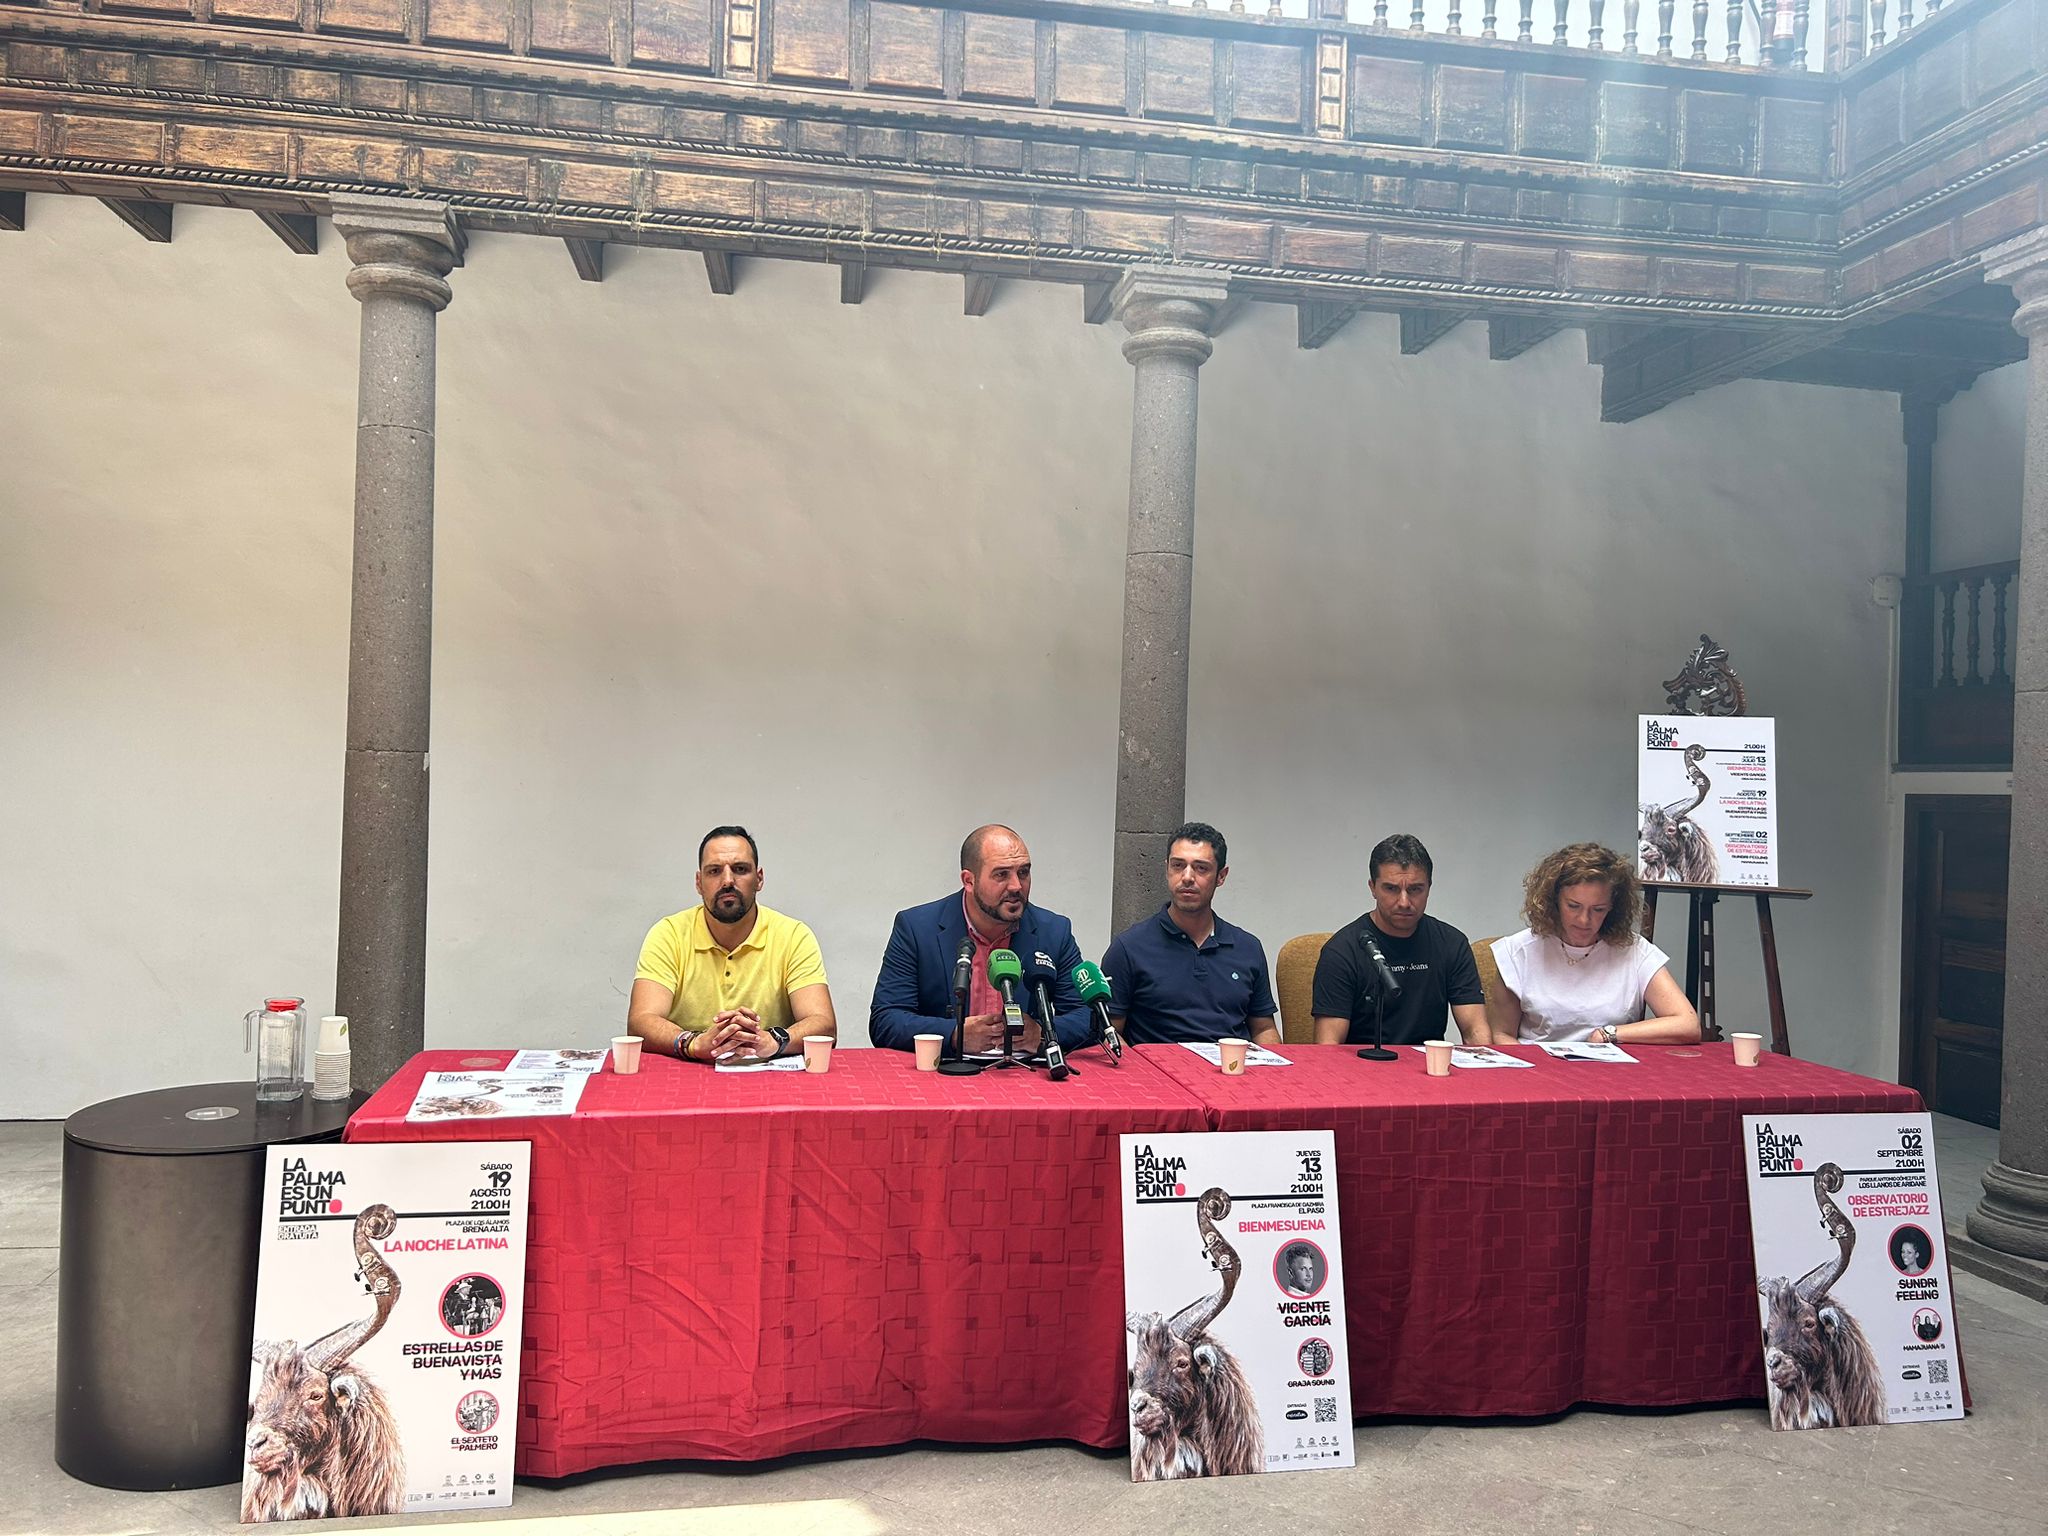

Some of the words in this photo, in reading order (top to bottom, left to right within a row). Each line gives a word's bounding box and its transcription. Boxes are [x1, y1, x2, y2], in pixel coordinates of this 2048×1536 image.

[1756, 1123, 1773, 1135] LA
[1757, 1135, 1802, 1147] PALMA
[1902, 1135, 1922, 1149] 02
[1134, 1145, 1154, 1158] LA
[1758, 1147, 1775, 1159] ES
[1776, 1147, 1794, 1159] UN
[1877, 1150, 1923, 1158] SEPTIEMBRE
[283, 1158, 306, 1172] LA
[1135, 1157, 1186, 1171] PALMA
[1301, 1158, 1321, 1172] 13
[282, 1171, 346, 1186] PALMA
[488, 1172, 511, 1188] 19
[1136, 1171, 1154, 1184] ES
[1156, 1170, 1176, 1183] UN
[1298, 1173, 1322, 1182] JULIO
[281, 1186, 305, 1200] ES
[306, 1186, 332, 1200] UN
[470, 1188, 511, 1198] AGOSTO
[1316, 1184, 1323, 1192] H
[502, 1200, 510, 1209] H
[1848, 1193, 1928, 1205] OBSERVATORIO
[1853, 1207, 1867, 1217] DE
[1869, 1206, 1930, 1216] ESTREJAZZ
[1239, 1219, 1325, 1232] BIENMESUENA
[384, 1240, 403, 1252] LA
[405, 1239, 455, 1252] NOCHE
[457, 1238, 508, 1250] LATINA
[1899, 1278, 1937, 1289] SUNDRI
[1897, 1290, 1939, 1301] FEELING
[1278, 1301, 1330, 1314] VICENTE
[1284, 1312, 1331, 1327] GARCÍA
[403, 1341, 483, 1356] ESTRELLAS
[484, 1340, 503, 1352] DE
[413, 1354, 502, 1369] BUENAVISTA
[460, 1369, 469, 1380] Y
[470, 1366, 501, 1379] MÁS
[460, 1436, 498, 1444] SEXTETO
[459, 1443, 498, 1451] PALMERO
